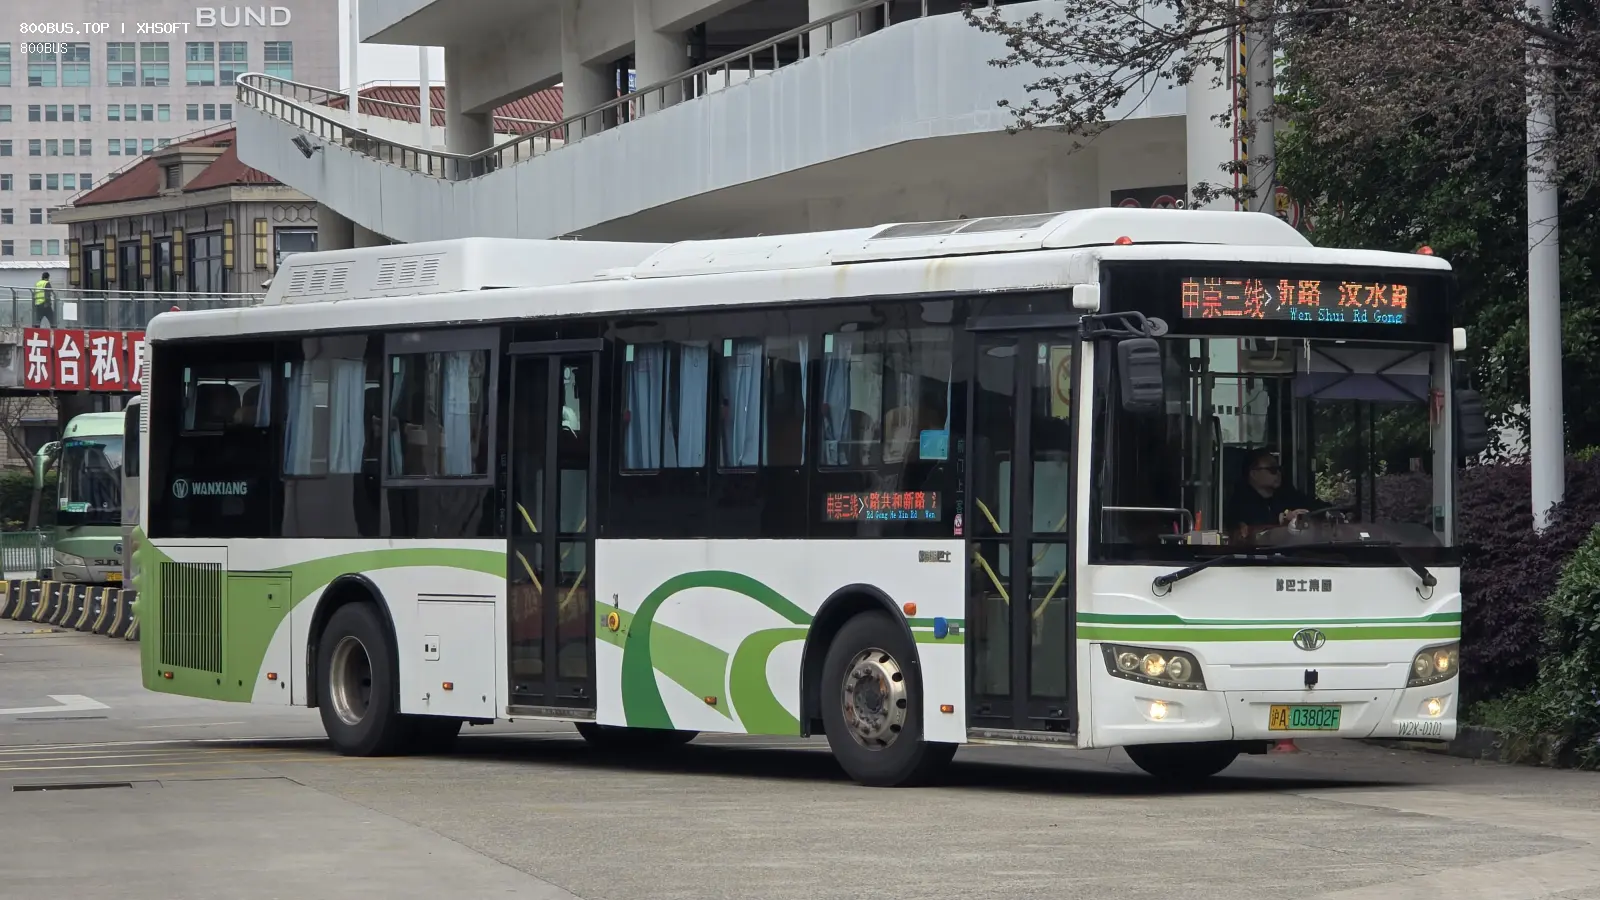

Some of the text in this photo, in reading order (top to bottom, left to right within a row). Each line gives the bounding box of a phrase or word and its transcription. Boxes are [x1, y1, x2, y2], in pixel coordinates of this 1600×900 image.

[195, 6, 291, 27] BUND
[1289, 307, 1403, 325] Wen Shui Rd Gong
[192, 481, 248, 495] WANXIANG
[1398, 722, 1443, 737] W2K-0101
